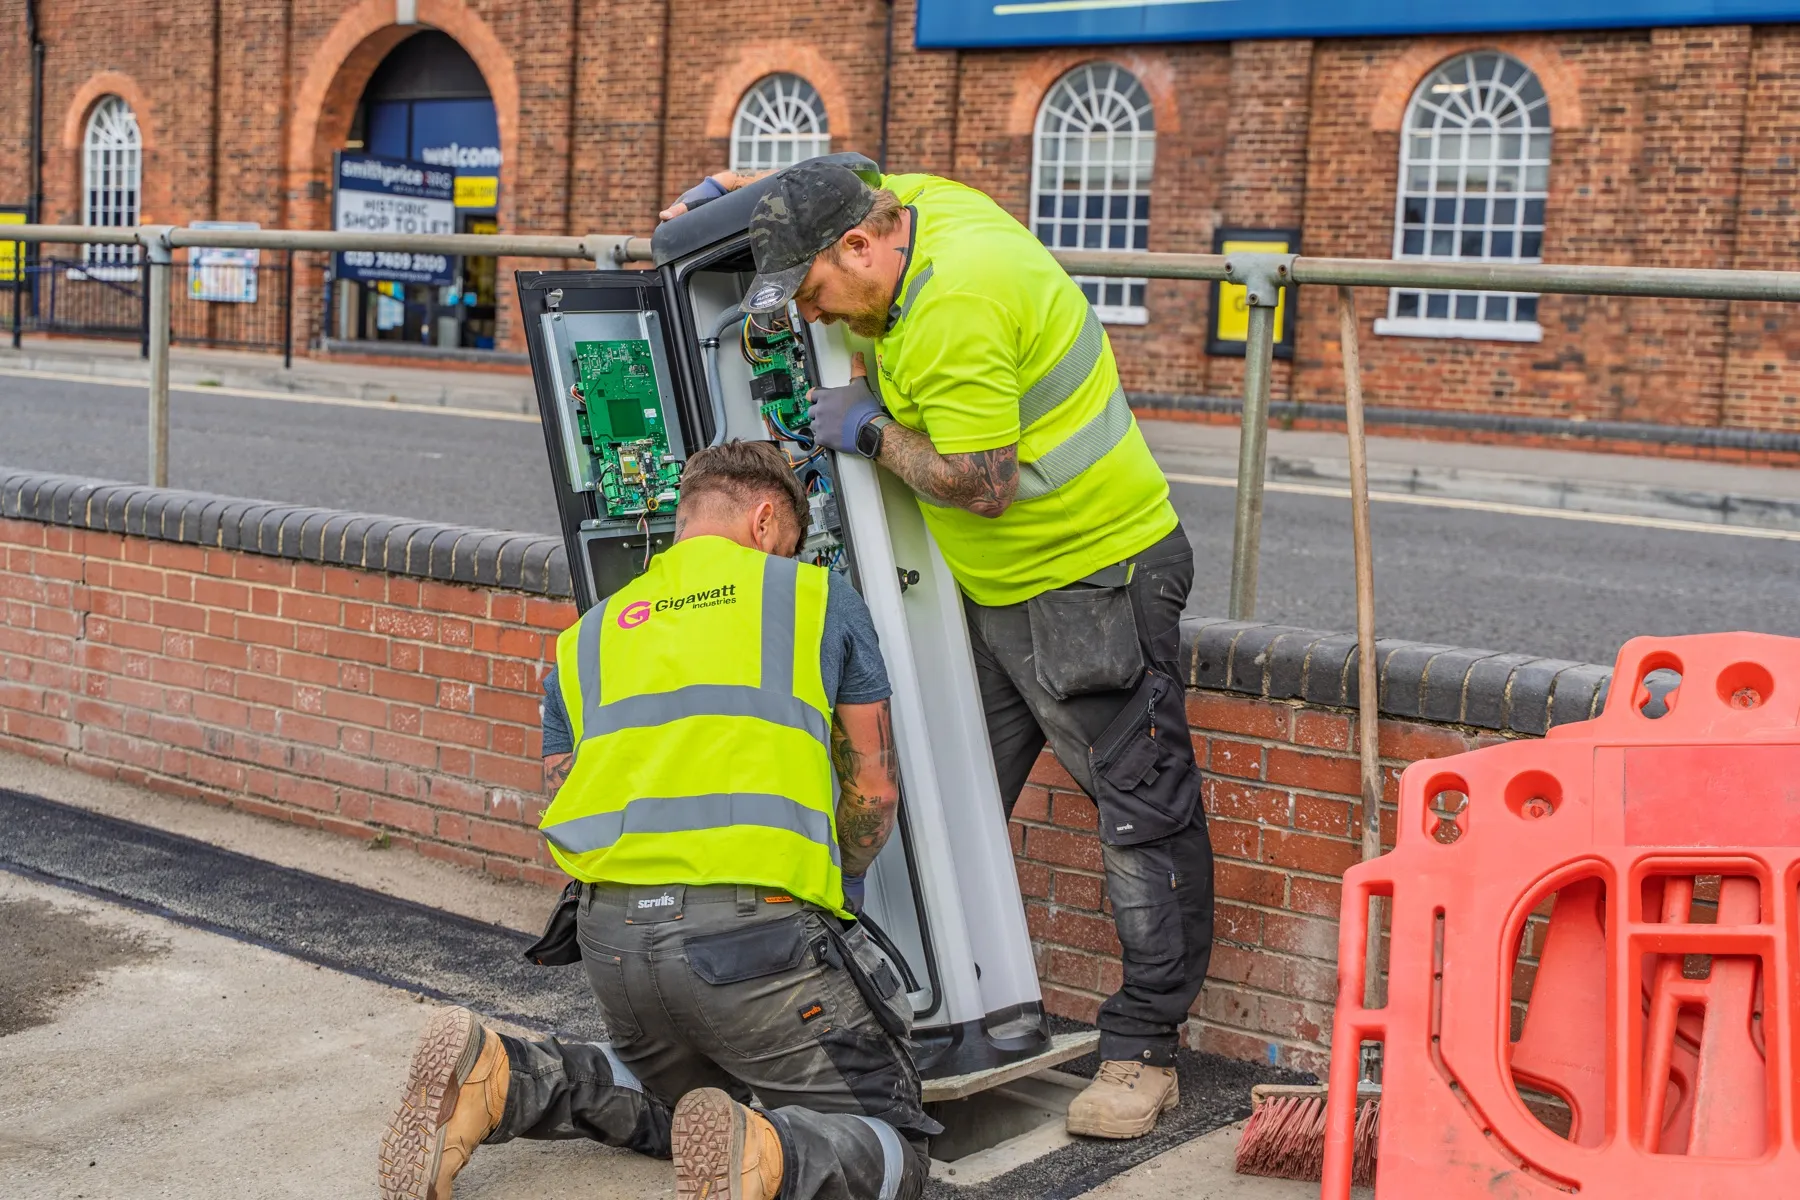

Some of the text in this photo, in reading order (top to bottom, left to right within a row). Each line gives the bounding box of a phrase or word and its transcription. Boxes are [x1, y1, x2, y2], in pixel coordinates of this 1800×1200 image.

[422, 142, 503, 168] welcom
[363, 199, 429, 217] HISTORIC
[343, 211, 451, 234] SHOP TO LET
[655, 584, 736, 612] Gigawatt
[692, 597, 737, 610] industries
[637, 892, 675, 909] scruffs
